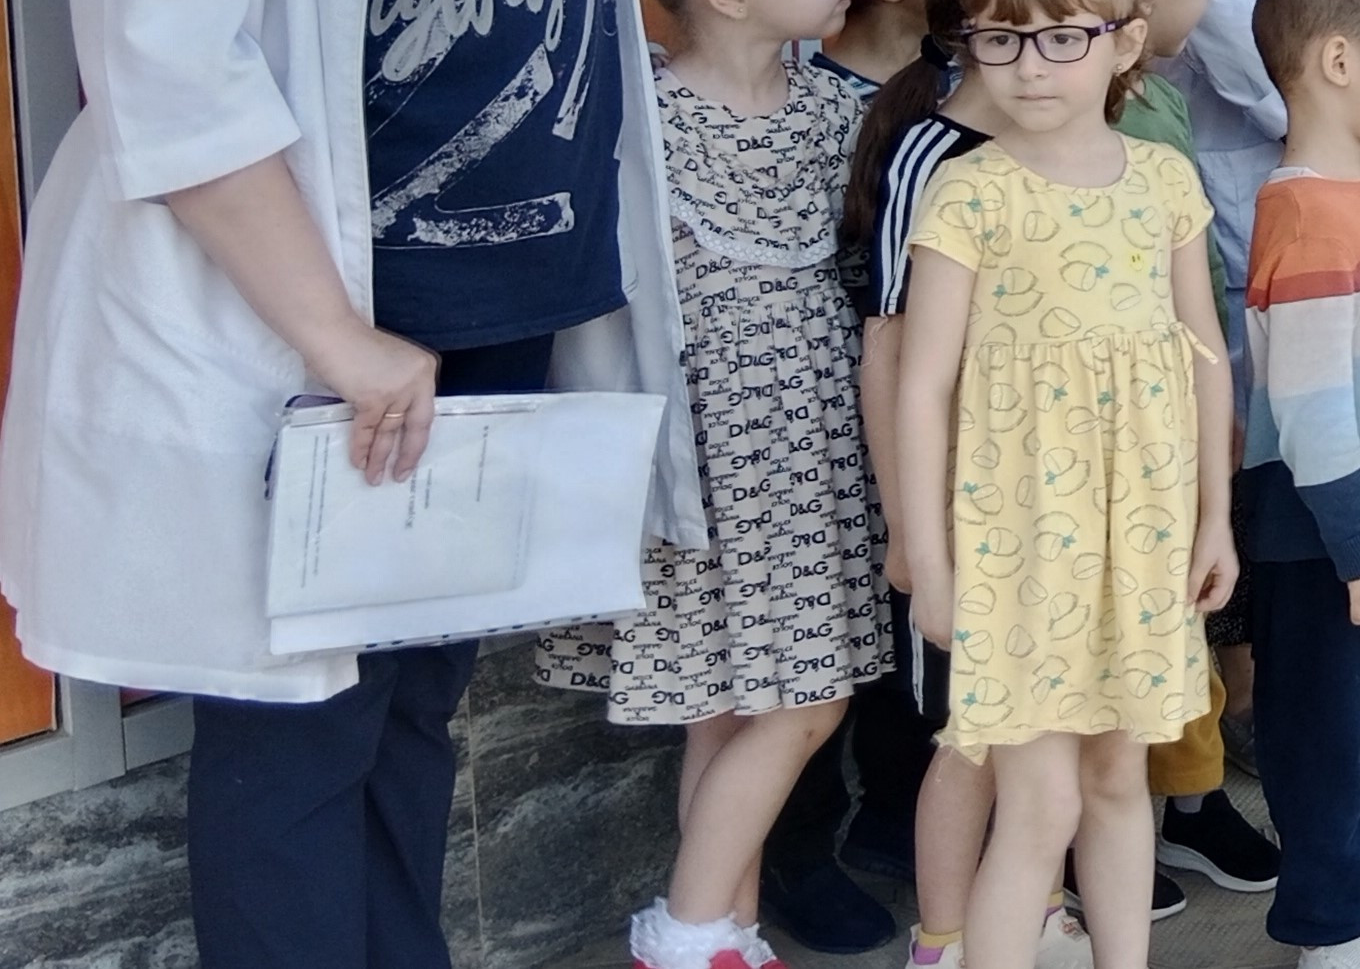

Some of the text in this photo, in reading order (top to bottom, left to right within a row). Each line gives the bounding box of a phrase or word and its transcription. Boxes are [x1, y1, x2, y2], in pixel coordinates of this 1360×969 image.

[736, 136, 774, 152] D&G
[696, 256, 732, 279] D&G
[759, 277, 798, 294] D&G
[733, 478, 771, 502] D&G
[790, 499, 823, 517] D&G
[792, 561, 828, 579] D&G
[793, 592, 831, 611] D&G
[793, 623, 833, 642] D&G
[795, 685, 838, 705] D&G
